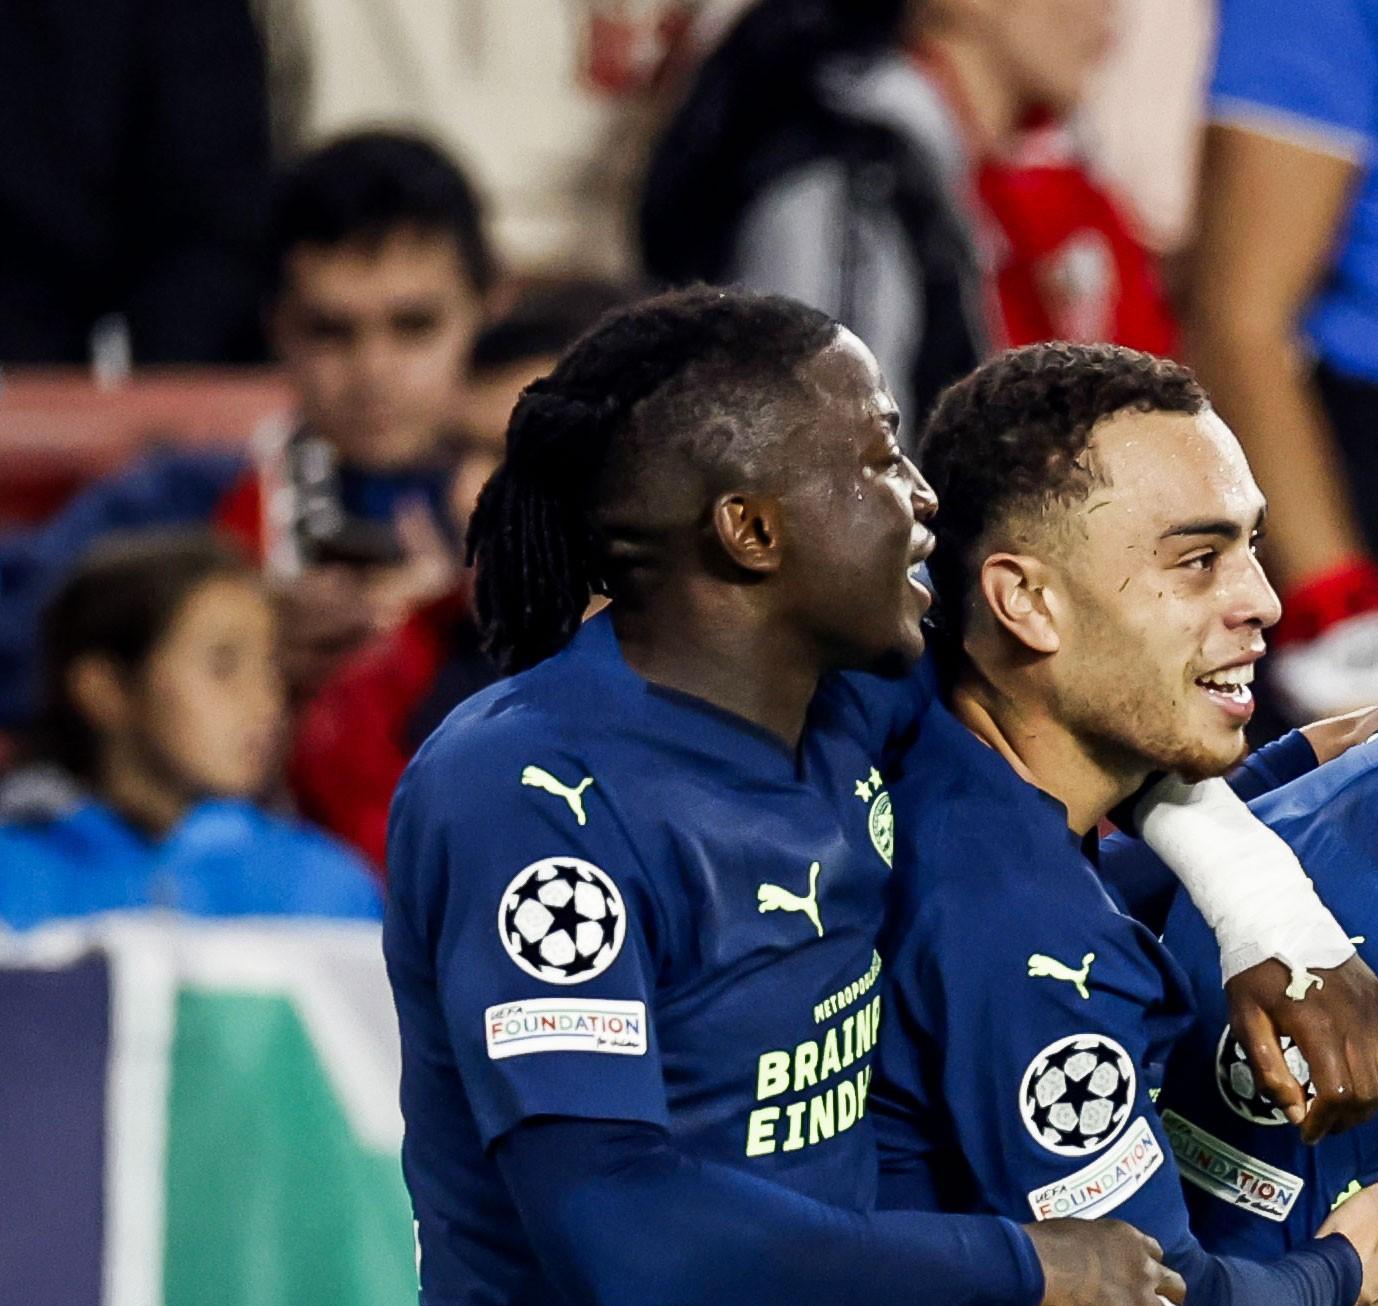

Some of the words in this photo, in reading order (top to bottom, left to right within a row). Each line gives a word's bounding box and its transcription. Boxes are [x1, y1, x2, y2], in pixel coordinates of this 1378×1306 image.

[491, 1015, 640, 1039] FOUNDATION
[756, 994, 881, 1101] BRAINP
[746, 1063, 873, 1158] EINDH
[1035, 1183, 1068, 1203] UEFA
[1039, 1134, 1153, 1218] FOUNDATION
[1168, 1131, 1293, 1206] OUNDATION
